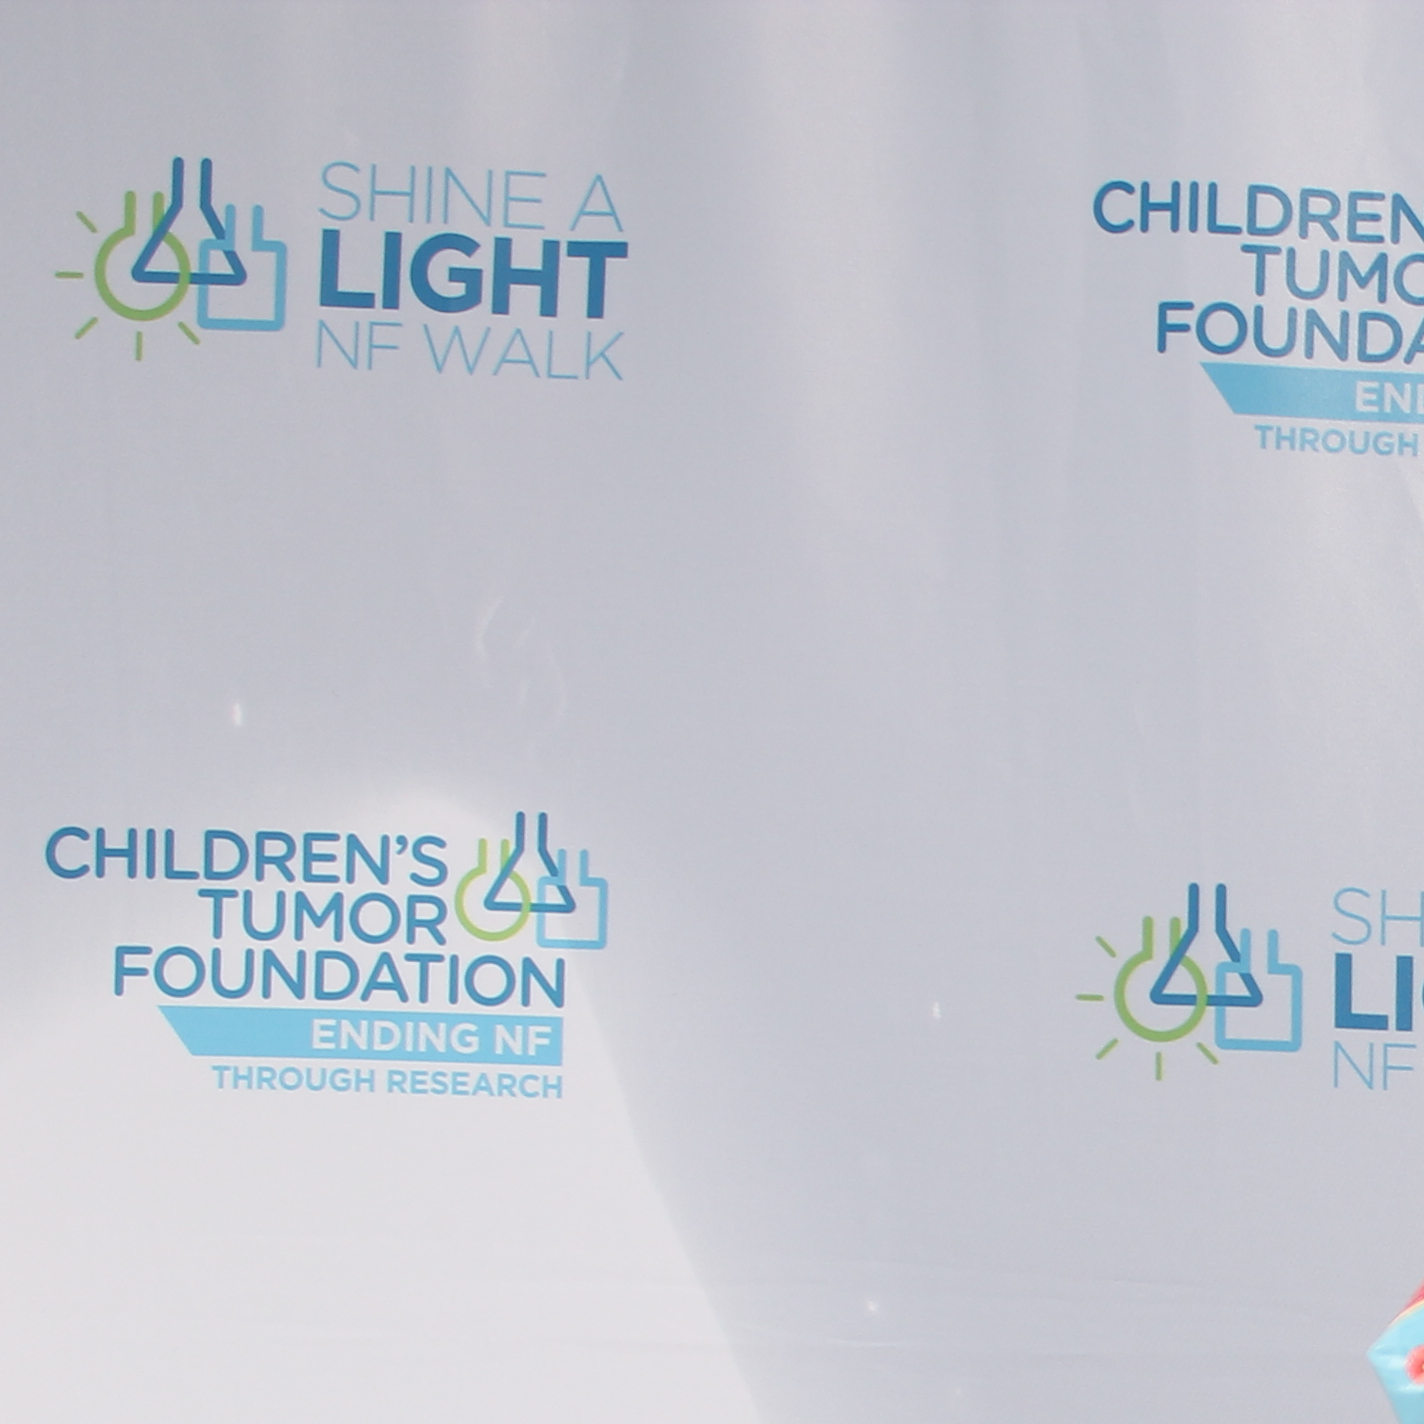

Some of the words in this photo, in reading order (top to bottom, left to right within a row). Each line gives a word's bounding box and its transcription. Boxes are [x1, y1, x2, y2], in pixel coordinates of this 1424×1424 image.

[319, 161, 547, 230] SHINE
[569, 174, 624, 232] A
[319, 228, 628, 319] LIGHT
[316, 319, 403, 370] NF
[423, 323, 625, 380] WALK
[1254, 424, 1419, 457] THROUGH
[45, 826, 448, 887] CHILDREN'S
[197, 888, 448, 945] TUMOR
[114, 945, 565, 1009] FOUNDATION
[311, 1019, 480, 1054] ENDING
[494, 1024, 551, 1055] NF
[1333, 1041, 1416, 1091] NF
[212, 1065, 375, 1094] THROUGH
[387, 1070, 563, 1099] RESEARCH
